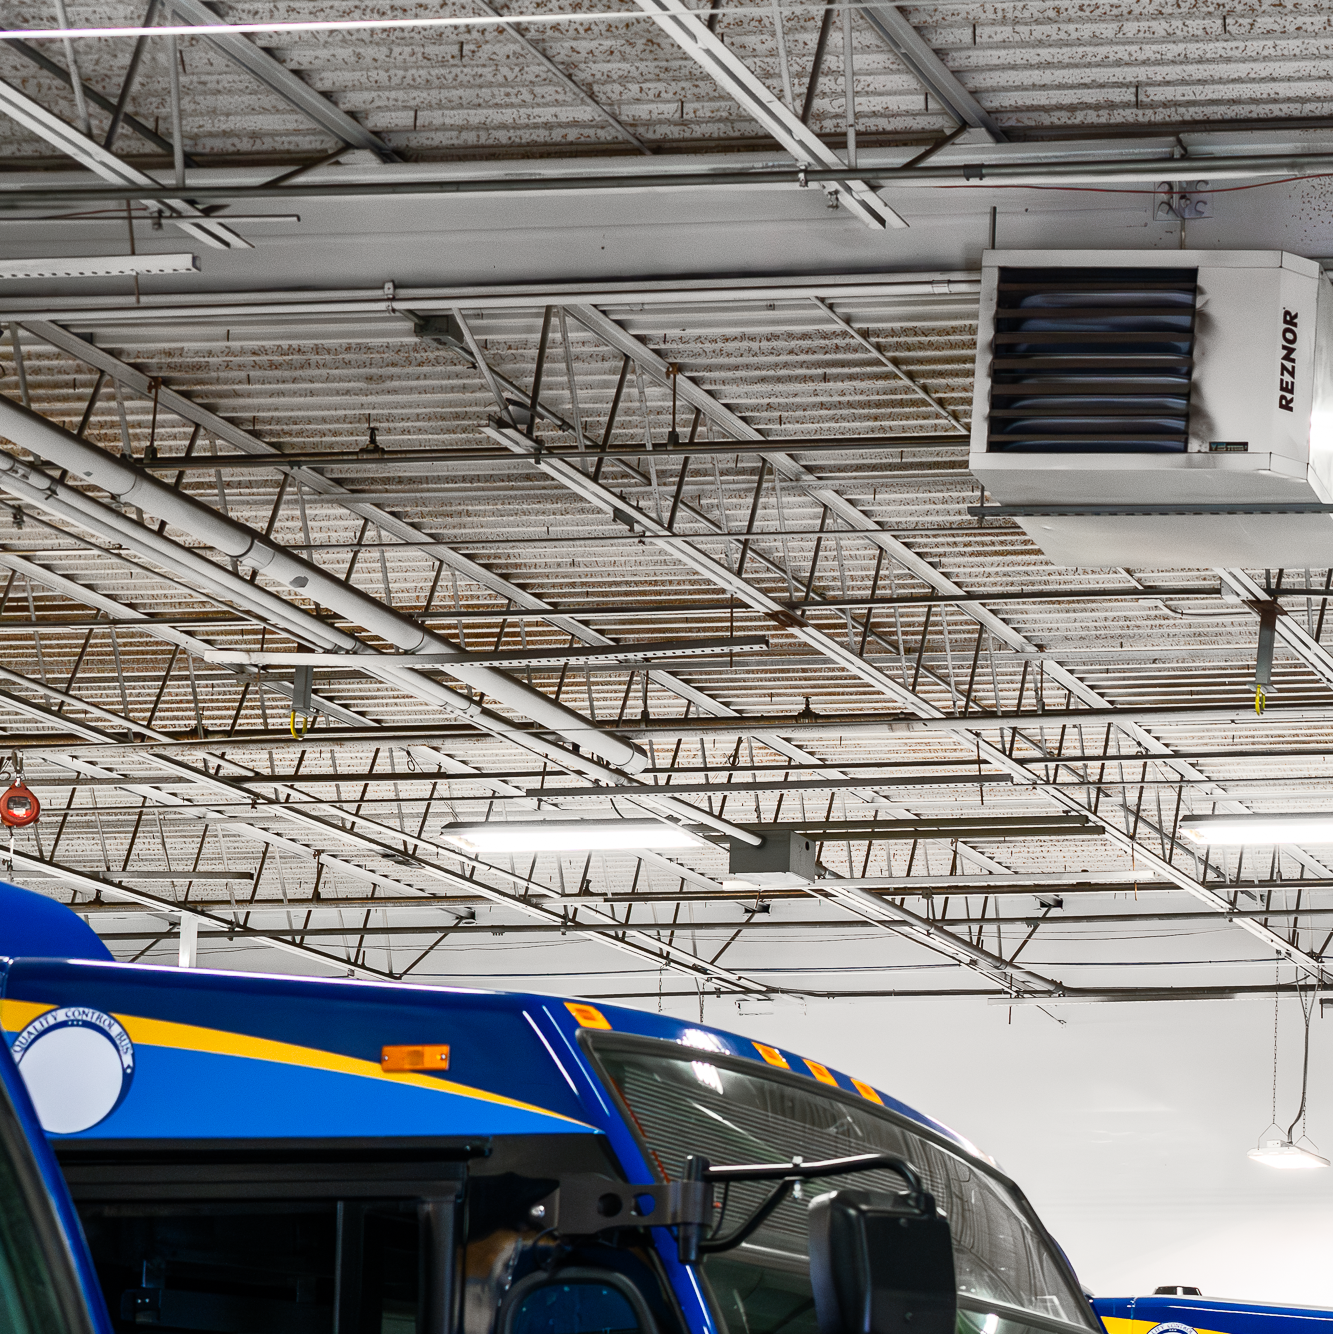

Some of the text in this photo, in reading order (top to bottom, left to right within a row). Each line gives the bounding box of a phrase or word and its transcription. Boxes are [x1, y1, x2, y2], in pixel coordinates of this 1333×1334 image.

[1278, 309, 1299, 413] REZNOR
[11, 1009, 131, 1055] QUALITY CONTROL BUS
